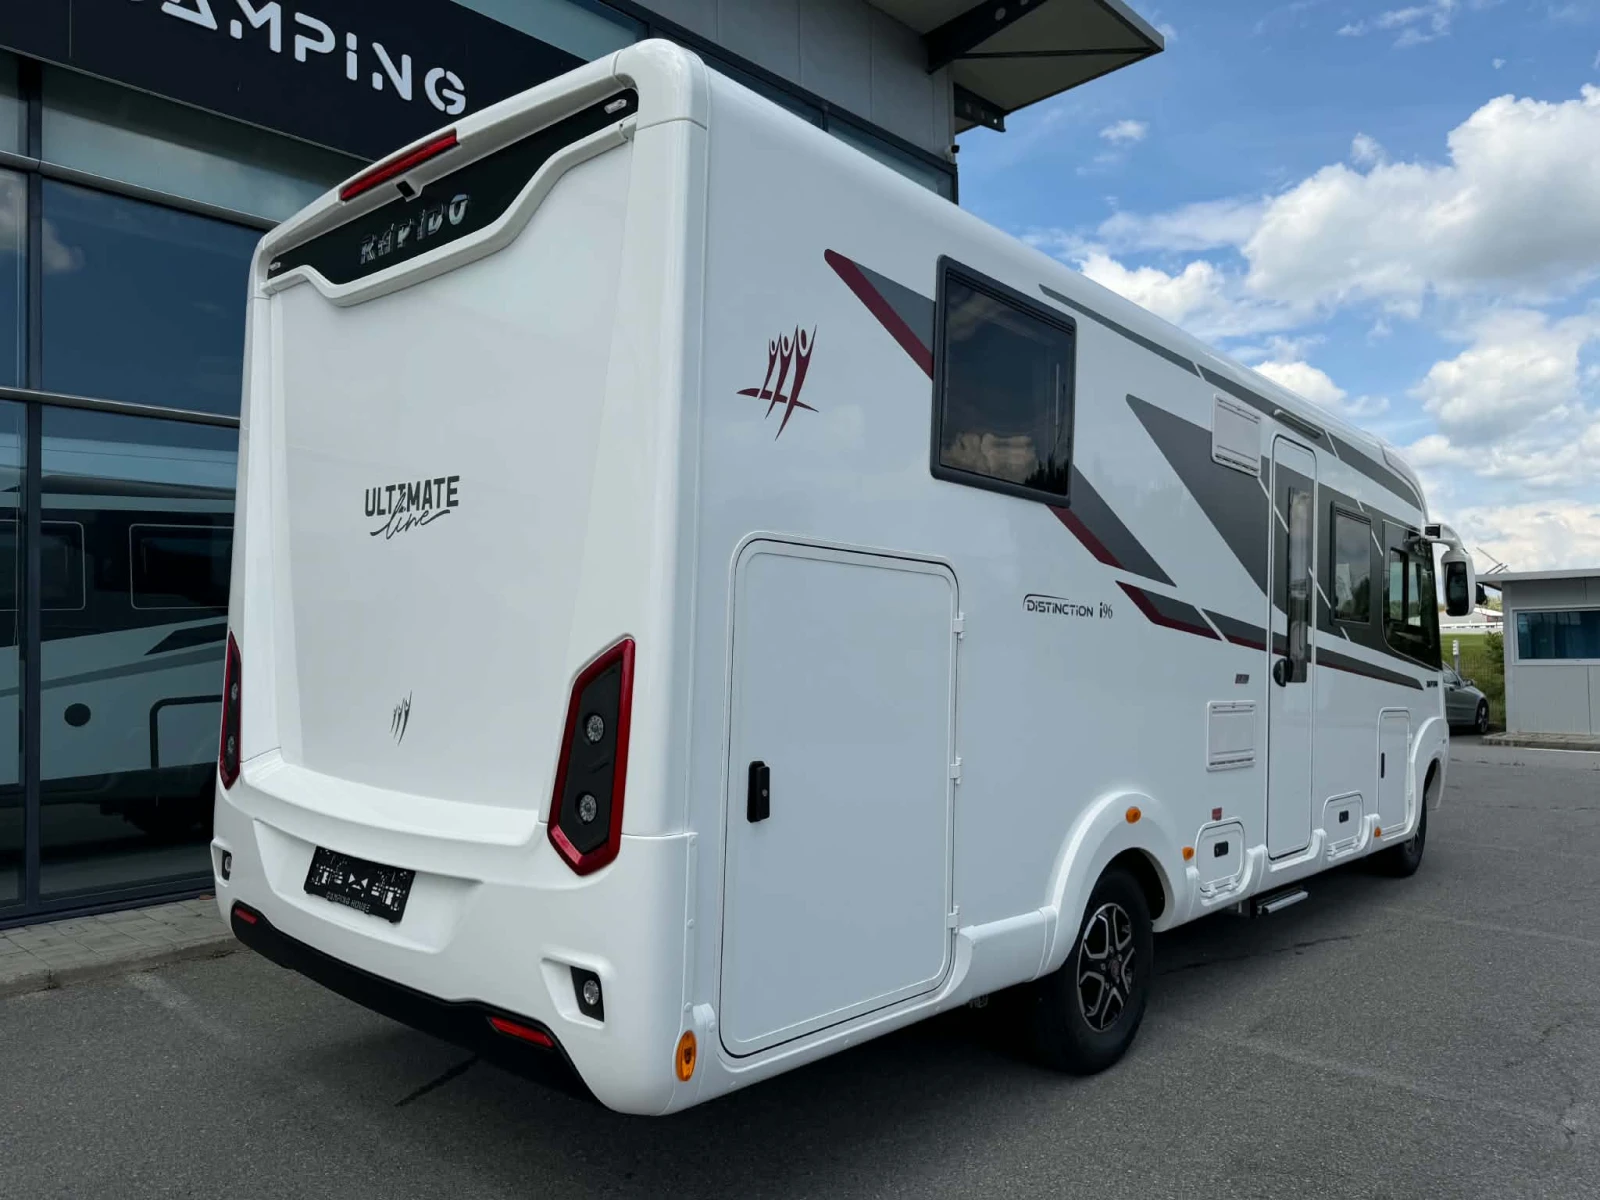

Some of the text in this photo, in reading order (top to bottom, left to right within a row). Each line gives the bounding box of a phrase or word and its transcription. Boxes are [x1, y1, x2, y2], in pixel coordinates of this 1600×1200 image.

[131, 0, 467, 115] AMPING
[360, 194, 469, 265] RAPIDO
[364, 475, 460, 517] ULTIMATE
[1099, 602, 1114, 620] i96
